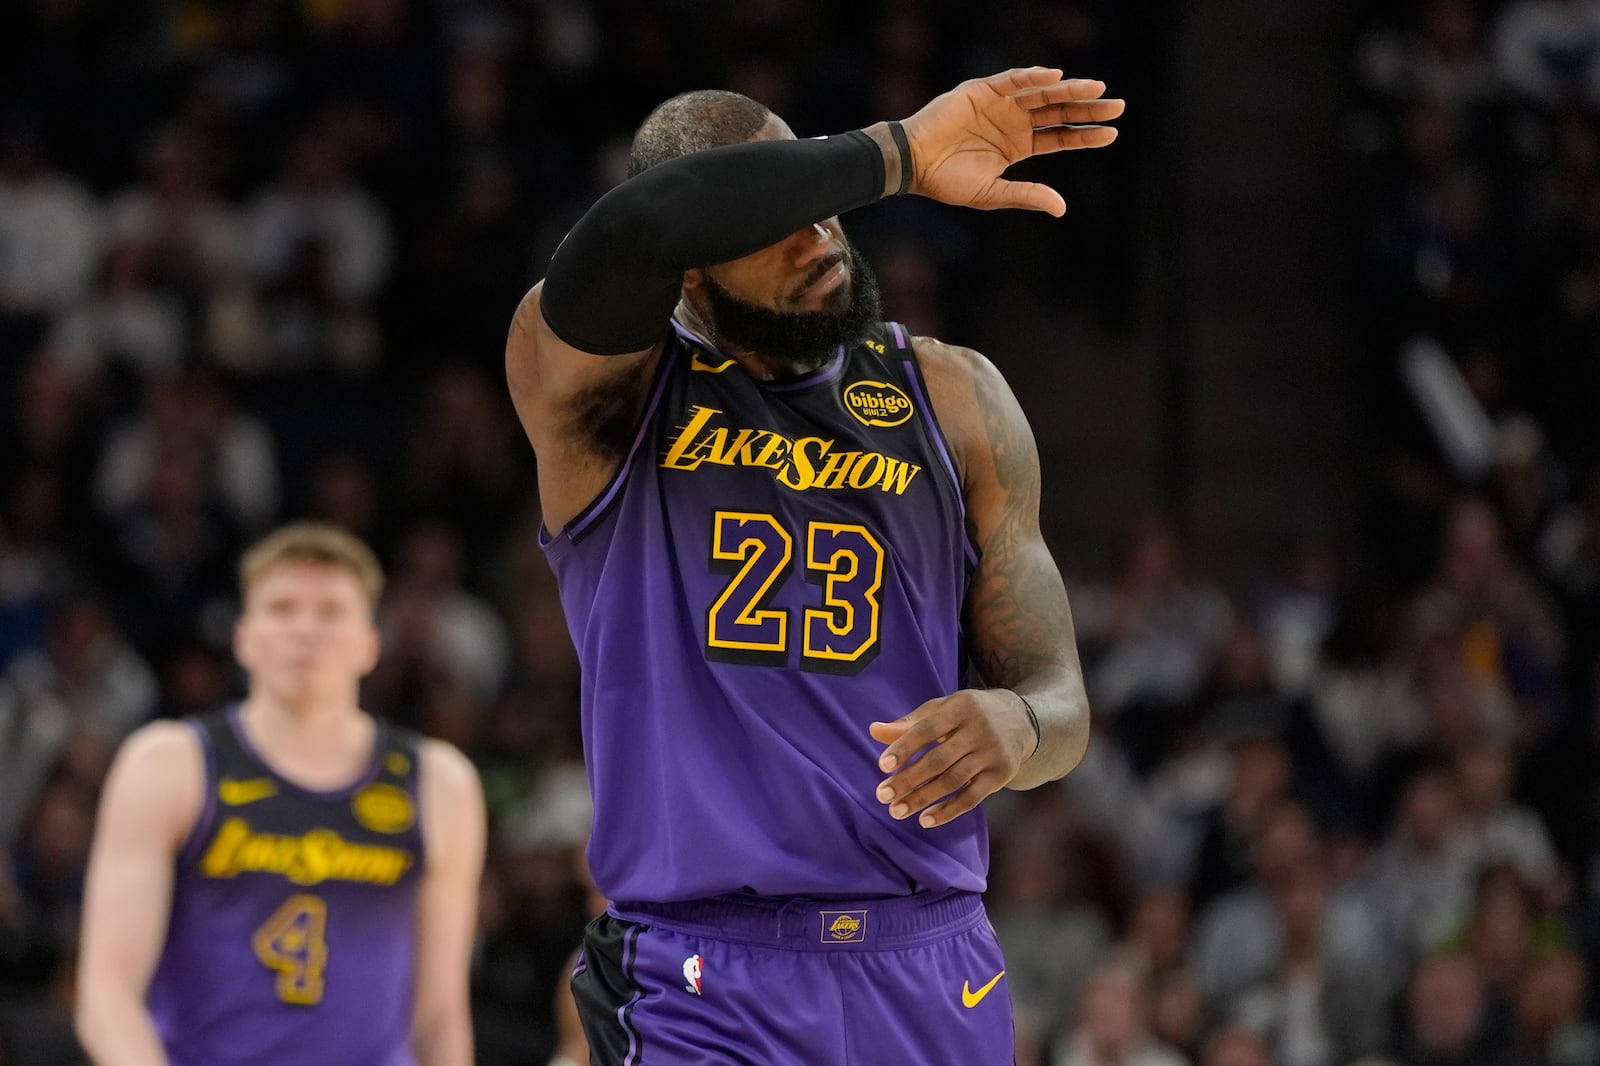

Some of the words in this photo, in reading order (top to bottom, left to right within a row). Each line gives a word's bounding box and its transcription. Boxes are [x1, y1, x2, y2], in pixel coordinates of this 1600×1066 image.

[849, 392, 908, 413] bibigo
[706, 508, 888, 676] 23
[253, 893, 328, 1007] 4
